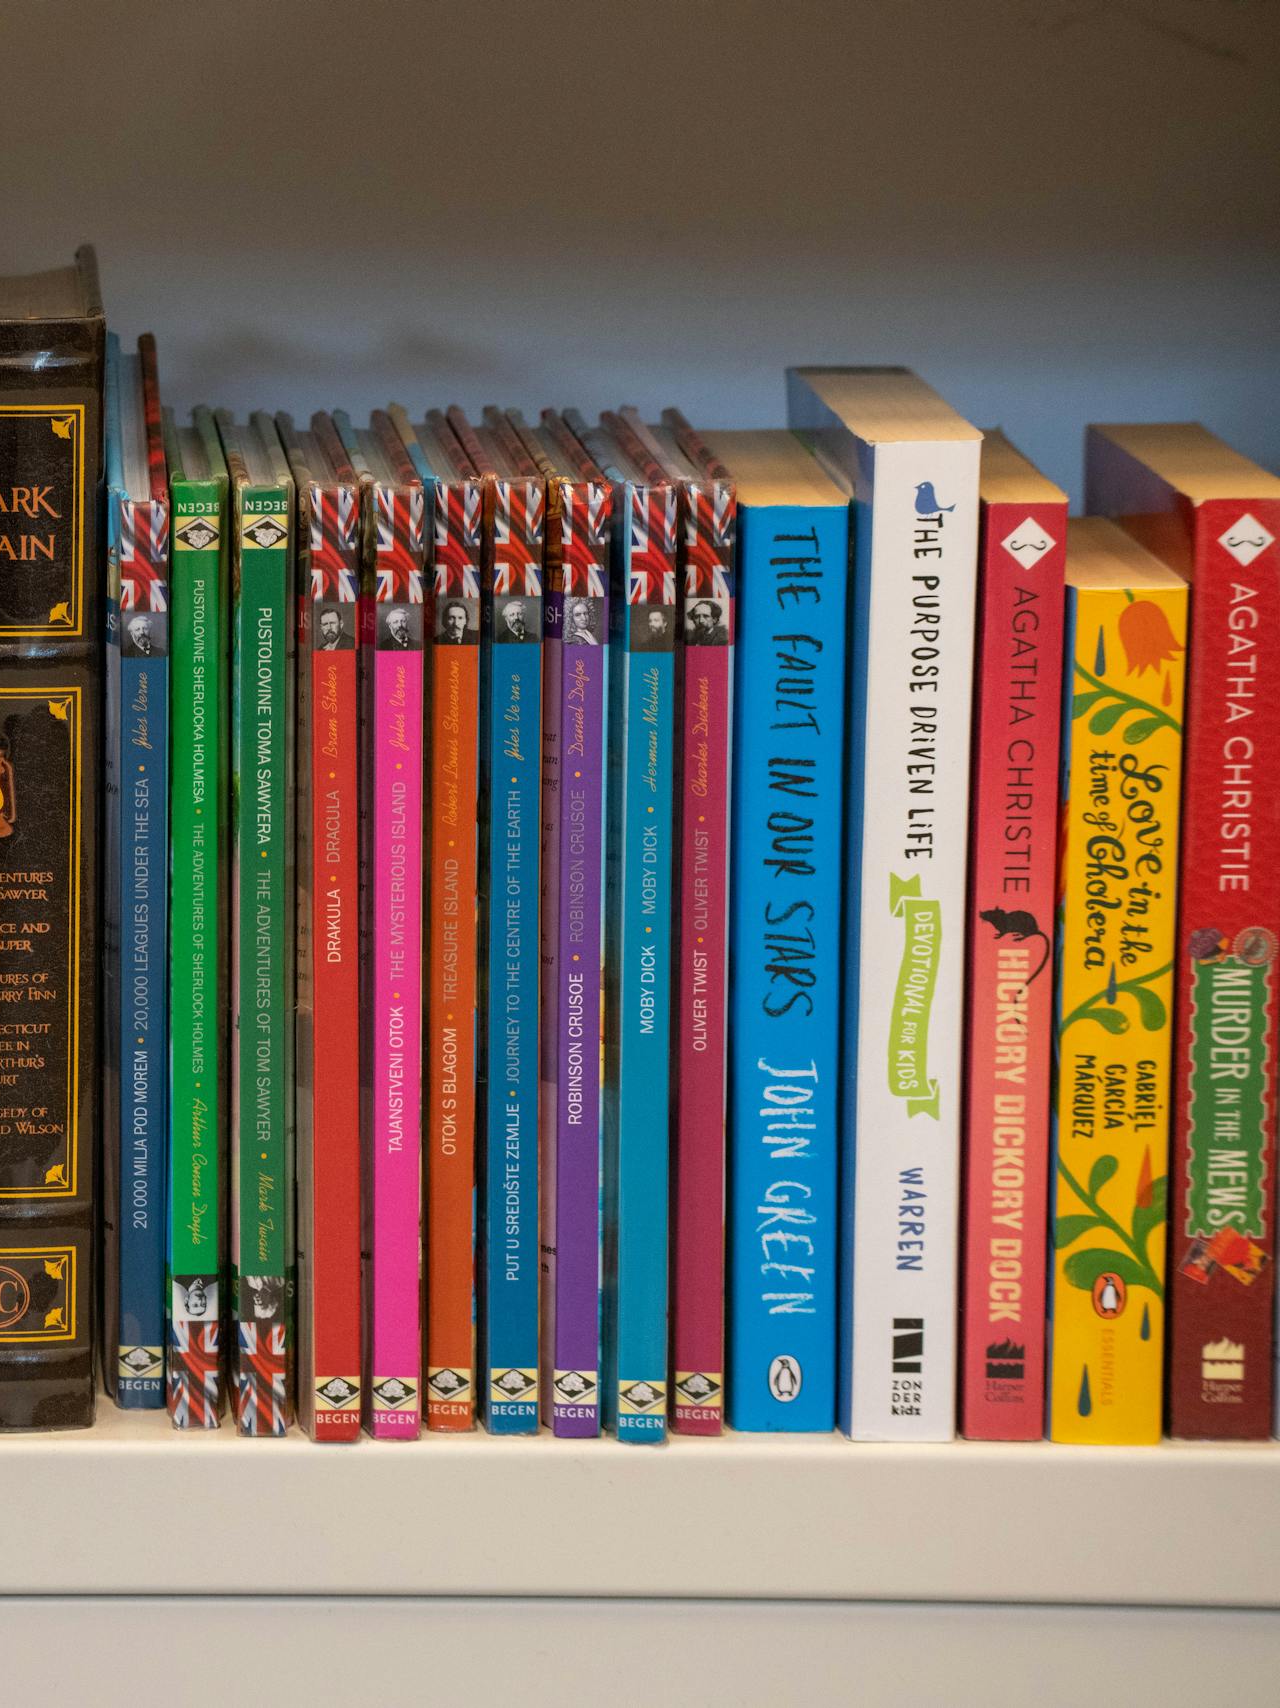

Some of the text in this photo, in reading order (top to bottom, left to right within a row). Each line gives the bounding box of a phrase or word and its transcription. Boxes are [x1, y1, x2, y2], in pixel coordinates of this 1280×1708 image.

[914, 514, 944, 559] THE
[909, 576, 940, 693] PURPOSE
[193, 580, 204, 804] PUSTOLOVINE SHERLOCKA HOLMESA
[257, 608, 272, 844] PUSTOLOVINE TOMA SAWYERA
[1003, 587, 1040, 893] AGATHA CHRISTIE
[1220, 583, 1258, 891] AGATHA CHRISTIE
[763, 527, 823, 1017] THE FAULT IN OUR STARS
[1088, 750, 1115, 807] time
[1119, 753, 1169, 875] Love
[326, 790, 340, 863] DRACULA
[21, 922, 50, 933] AND
[134, 778, 149, 1030] 20,000 LEAGUES UNDER THE SEA
[327, 888, 341, 963] DRAKULA
[506, 791, 521, 1084] JOURNEY TO THE CENTRE OF THE EARTH
[1084, 824, 1131, 970] Cholera
[28, 988, 56, 1000] FINN
[32, 973, 49, 984] OF
[640, 945, 655, 1034] MOBY DICK
[693, 949, 707, 1051] OLIVER TWIST
[896, 911, 933, 1090] DEVOTIONAL FOR KIDS
[17, 1039, 29, 1050] IN
[134, 1051, 148, 1103] MOREM
[389, 1006, 404, 1154] TAJANSTVENI OTOK
[442, 1028, 457, 1155] OTOK S BLAGOM
[568, 973, 583, 1124] ROBINSON CRUSOE
[15, 1122, 63, 1134] WILSON
[31, 1107, 48, 1117] OF
[133, 1107, 148, 1135] POD
[989, 949, 1029, 1322] HICKORY DICKORY DOCK
[1207, 968, 1252, 1226] MURDER IN THE MEWS
[133, 1138, 148, 1176] MILJA
[502, 1104, 520, 1281] PUT U SREDIŠTE ZEMLJE
[756, 1057, 818, 1314] JOHN GREEN
[133, 1210, 147, 1228] 20
[896, 1168, 928, 1271] WARREN
[316, 1414, 359, 1424] BEGEN
[491, 1405, 536, 1416] BEGEN
